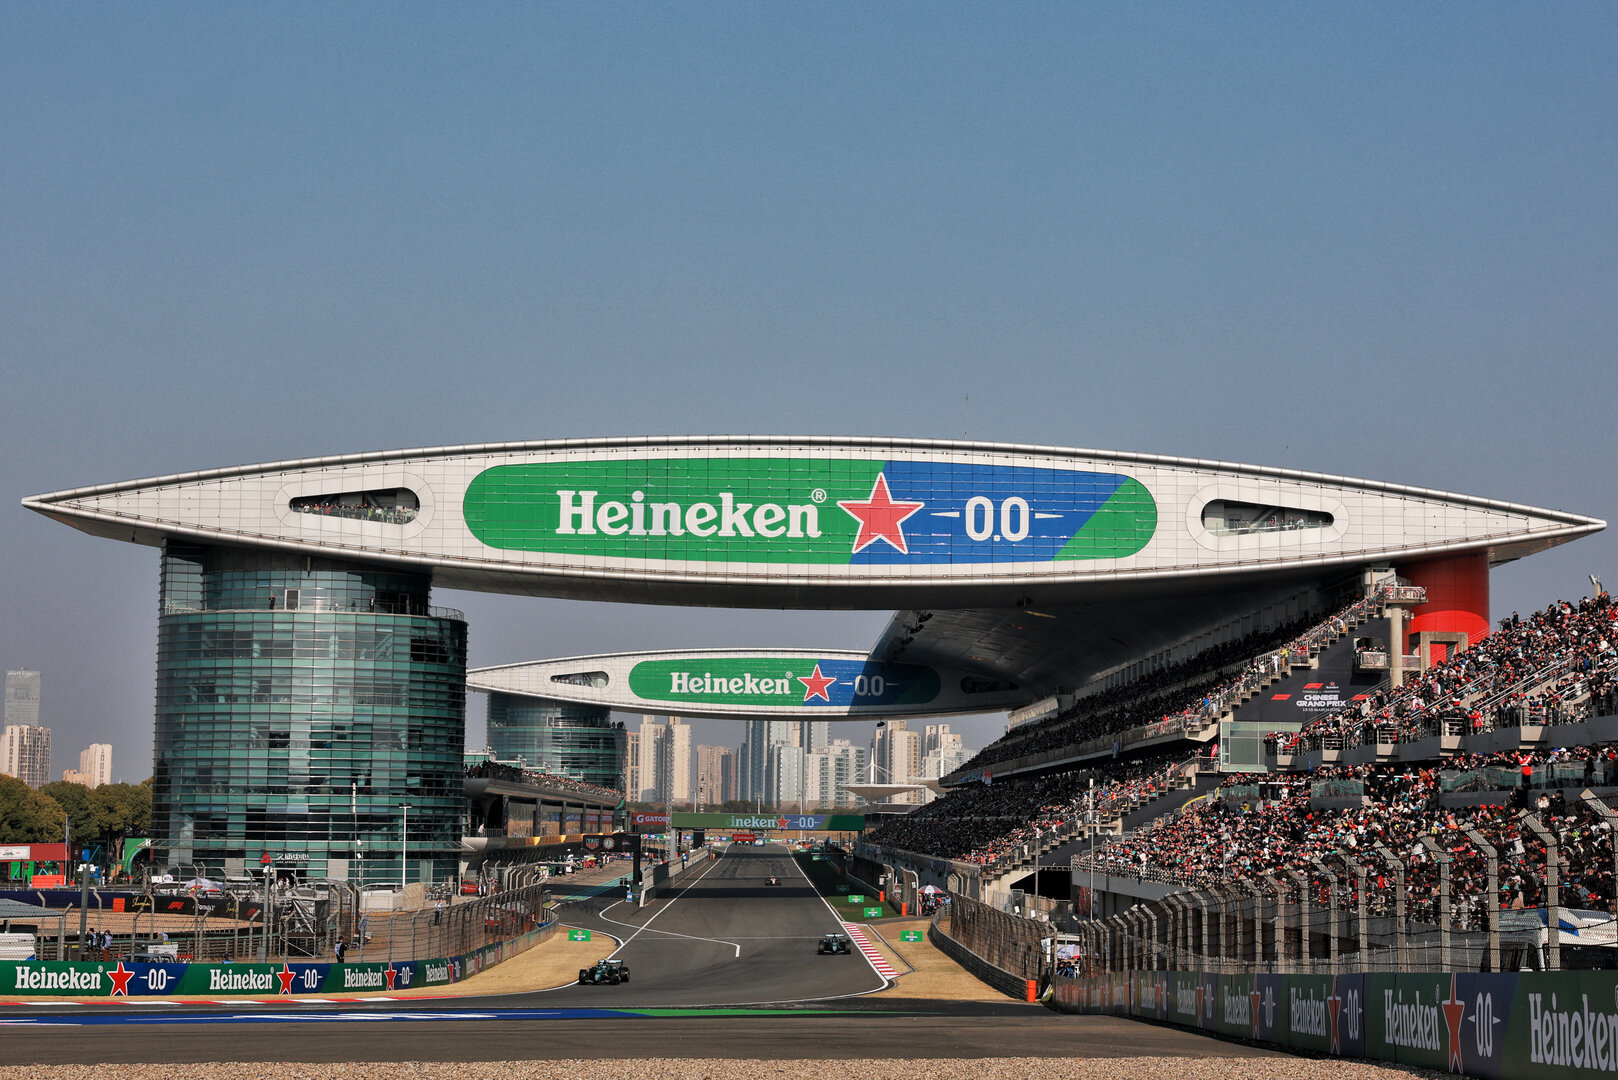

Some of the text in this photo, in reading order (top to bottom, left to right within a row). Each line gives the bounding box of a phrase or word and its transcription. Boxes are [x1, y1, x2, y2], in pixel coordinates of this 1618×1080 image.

[964, 495, 1031, 543] 0.0
[854, 675, 884, 697] 0.0
[15, 966, 167, 990] Heineken 0.0
[209, 968, 318, 990] Heineken 0.0
[1384, 988, 1440, 1050] Heineken
